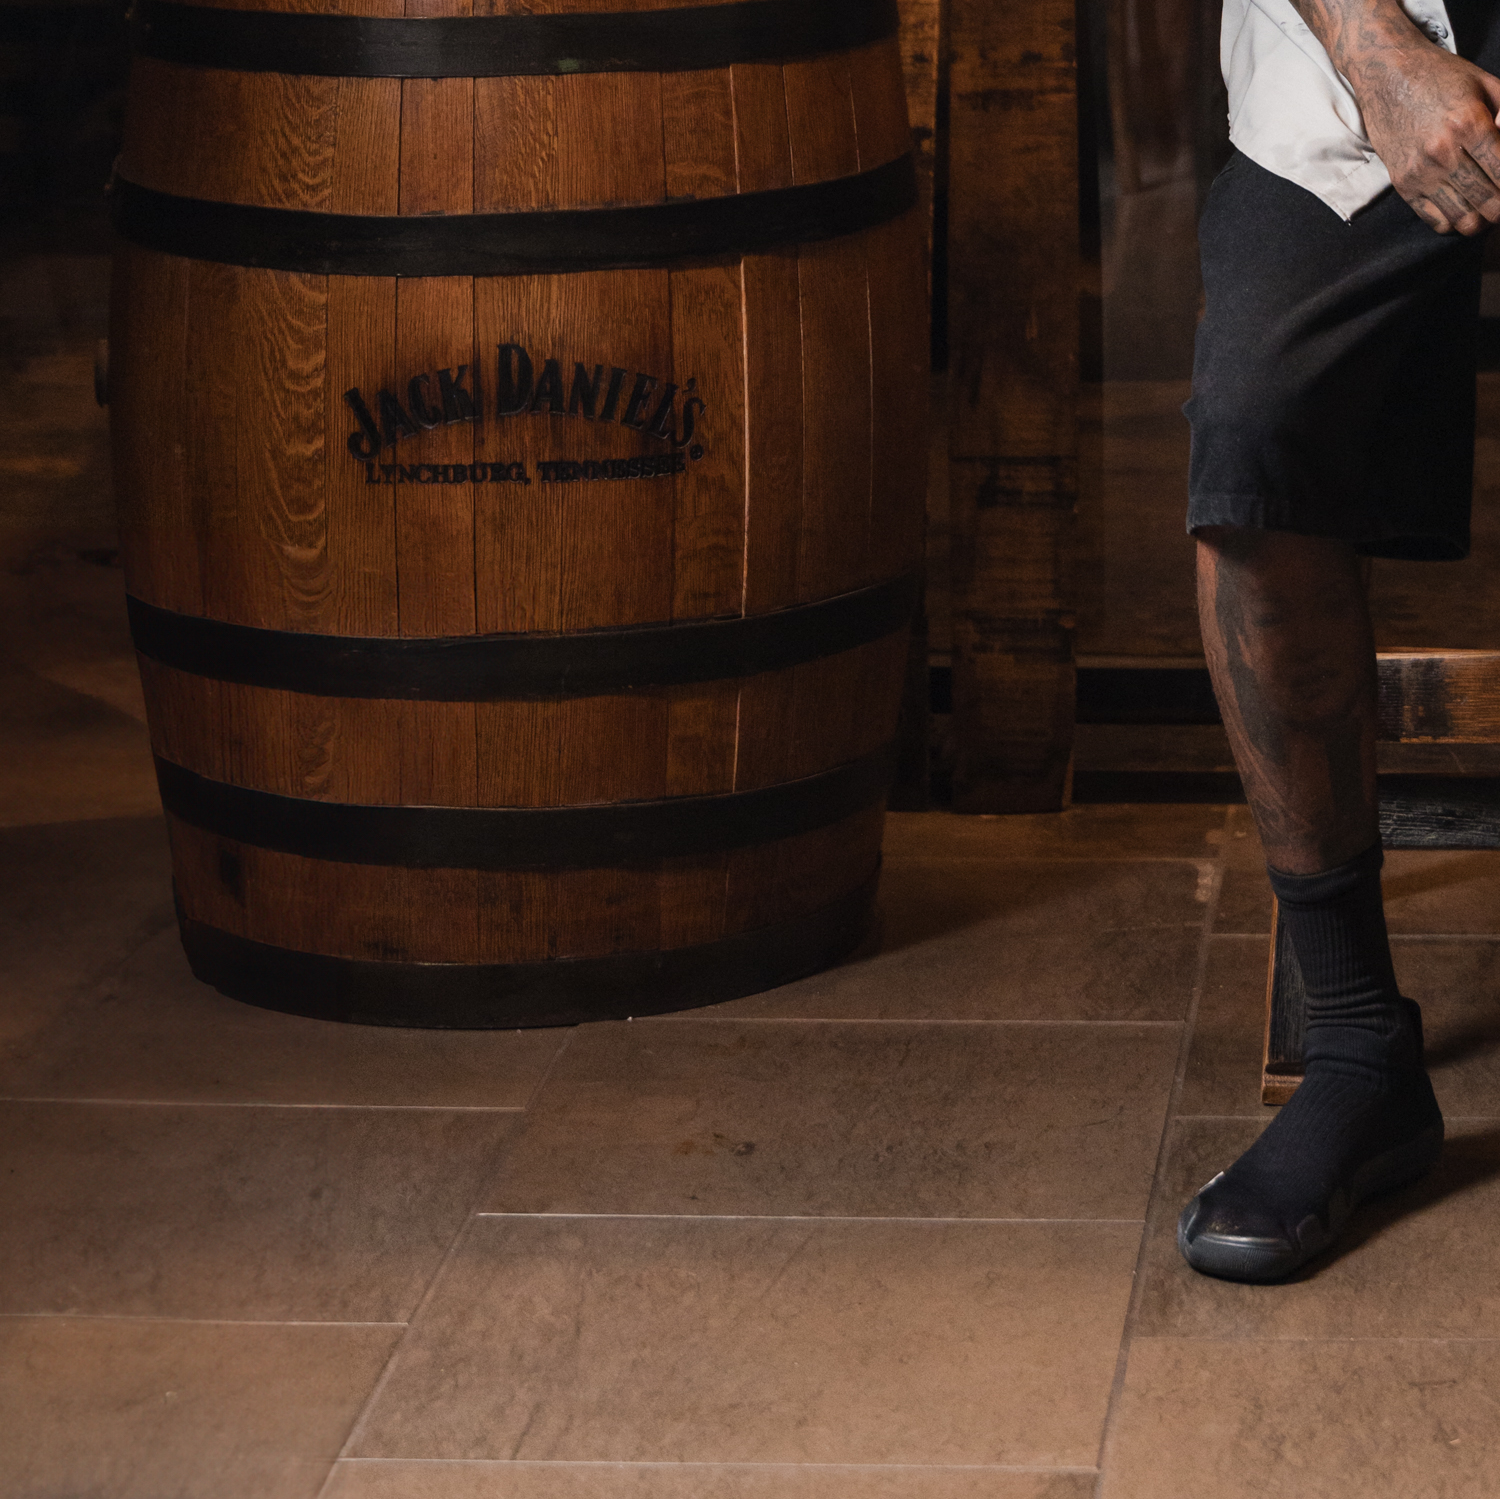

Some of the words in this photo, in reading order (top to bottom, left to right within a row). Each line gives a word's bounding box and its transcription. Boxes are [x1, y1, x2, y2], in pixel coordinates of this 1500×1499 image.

[343, 364, 482, 462] JACK
[497, 342, 706, 449] DANIEL'S
[365, 460, 532, 486] LYNCHBURG,
[537, 452, 686, 483] TENNESSEE
